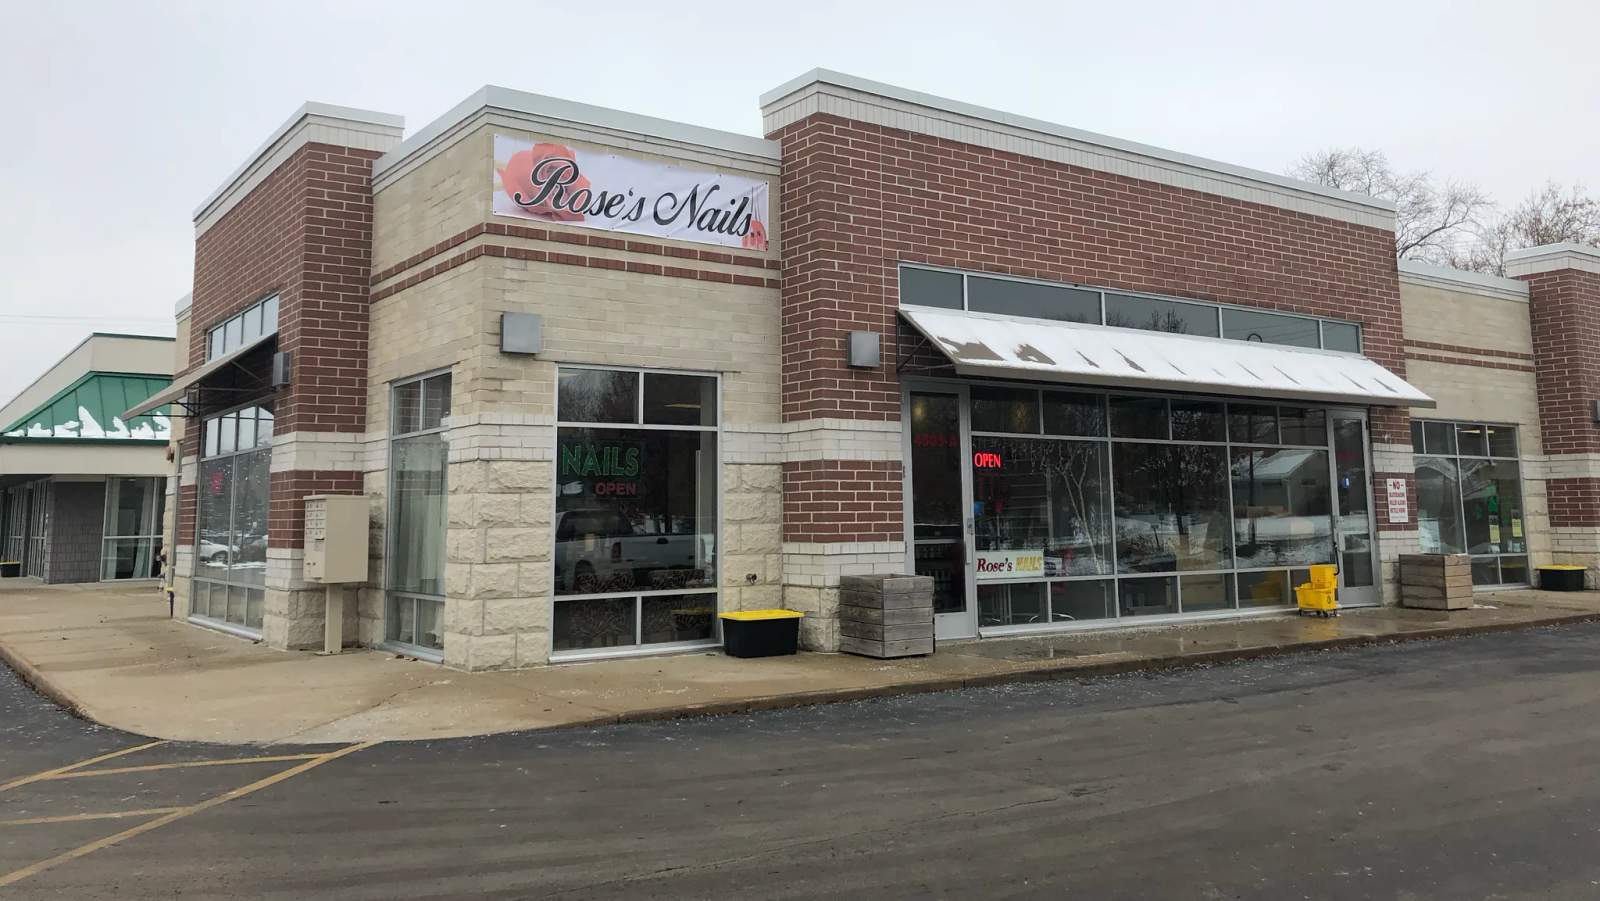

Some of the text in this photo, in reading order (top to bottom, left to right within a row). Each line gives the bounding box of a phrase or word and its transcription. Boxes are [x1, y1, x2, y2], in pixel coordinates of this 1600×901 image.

[514, 158, 752, 237] Rose's Nails
[562, 444, 639, 476] NAILS
[974, 452, 1001, 468] OPEN
[595, 482, 637, 496] OPEN
[976, 557, 1013, 572] Rose's
